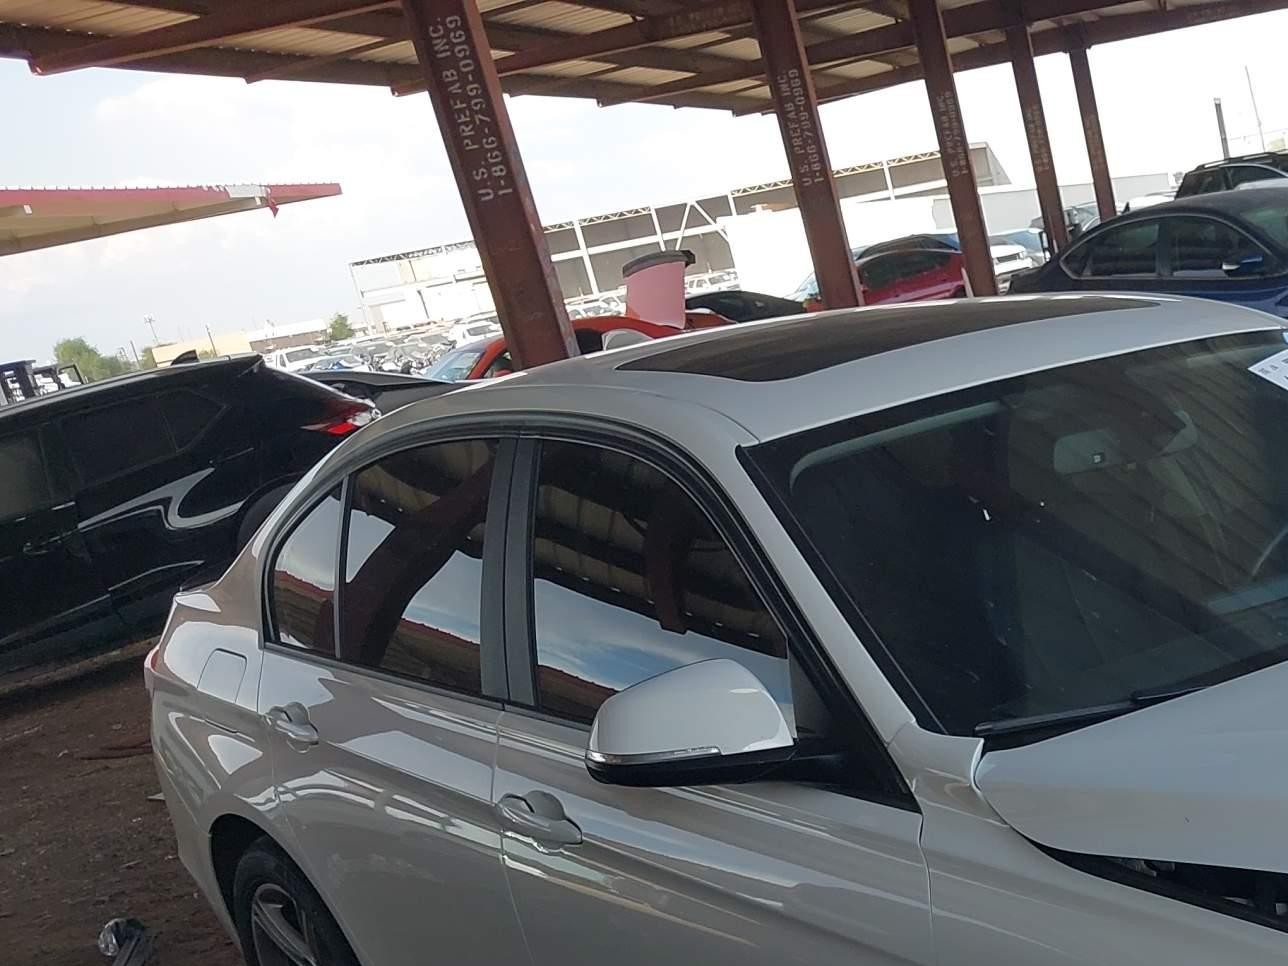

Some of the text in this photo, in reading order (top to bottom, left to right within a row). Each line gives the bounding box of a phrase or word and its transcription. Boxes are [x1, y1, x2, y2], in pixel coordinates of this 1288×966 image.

[429, 17, 495, 202] U.S. PREFAB INC.
[446, 15, 514, 196] 1-866-799-0969
[784, 102, 806, 155] PREFAB
